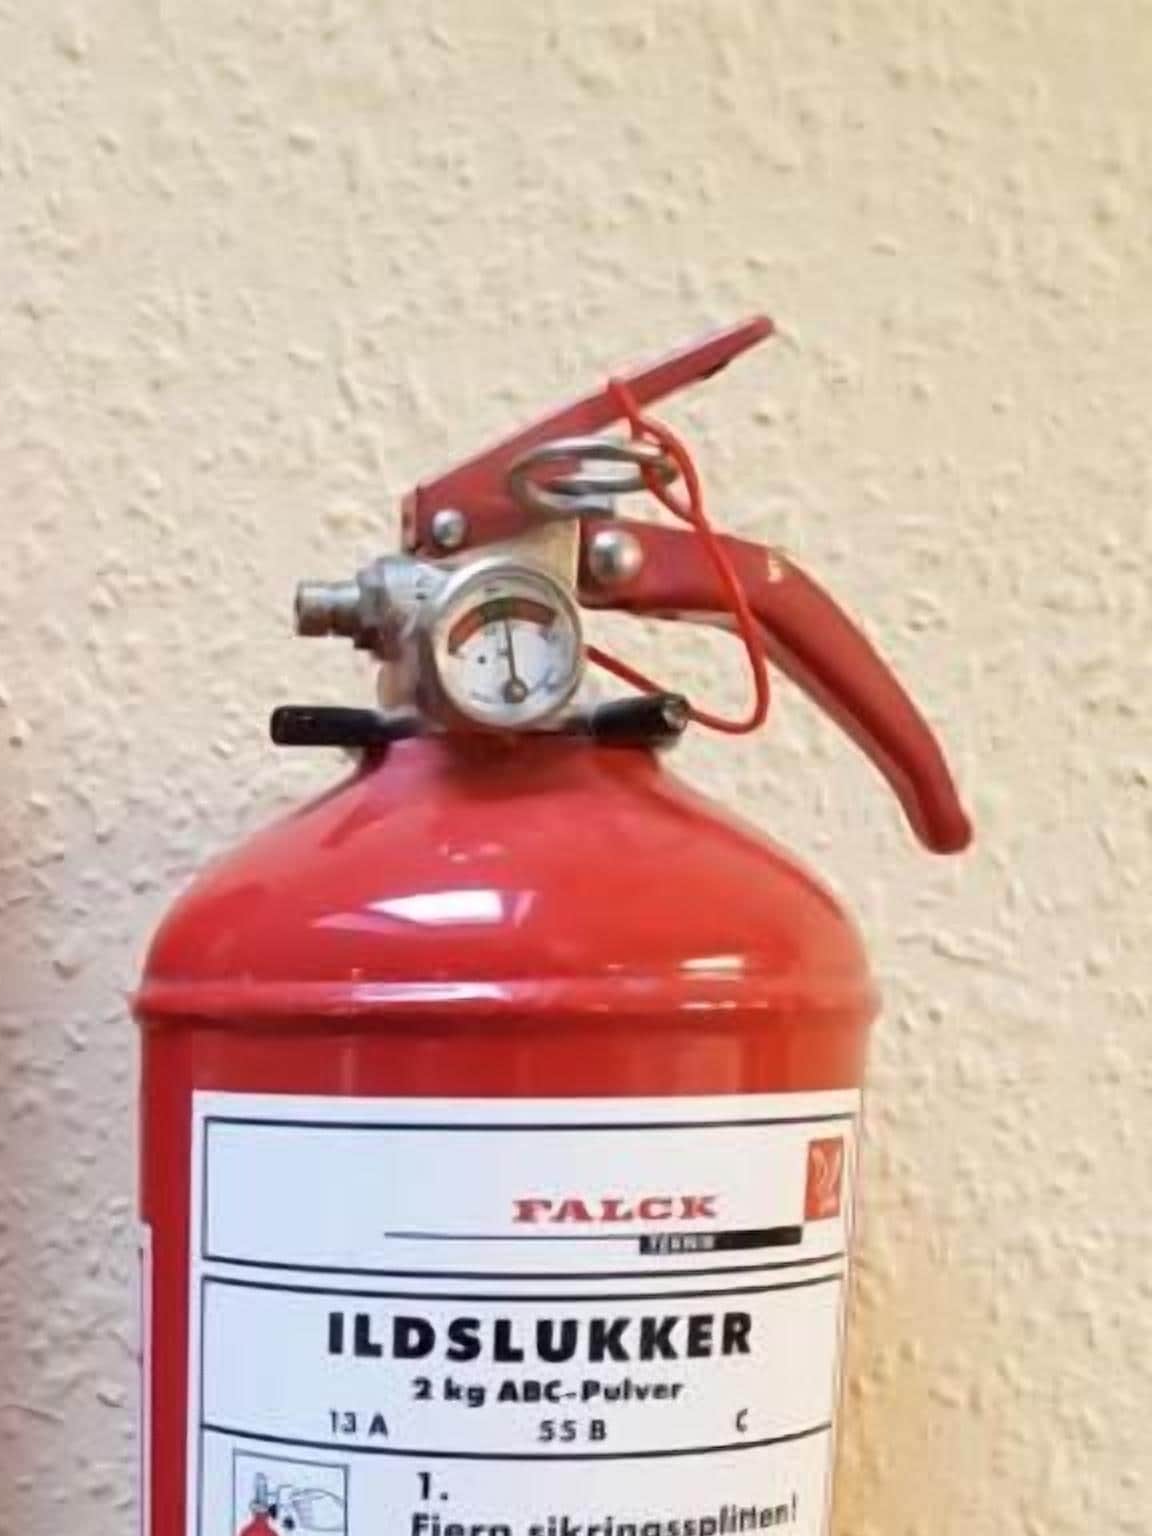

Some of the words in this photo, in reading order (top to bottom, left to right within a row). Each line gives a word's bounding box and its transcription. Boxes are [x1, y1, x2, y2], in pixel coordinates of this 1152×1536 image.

[512, 1195, 719, 1224] FALCK
[327, 1310, 752, 1364] ILDSLUKKER
[411, 1378, 434, 1401] 2
[444, 1378, 487, 1408] kg
[497, 1378, 686, 1404] ABC-Pulver
[329, 1410, 358, 1436] 13
[368, 1412, 389, 1439] A
[588, 1418, 608, 1442] B
[417, 1471, 450, 1502] 1.
